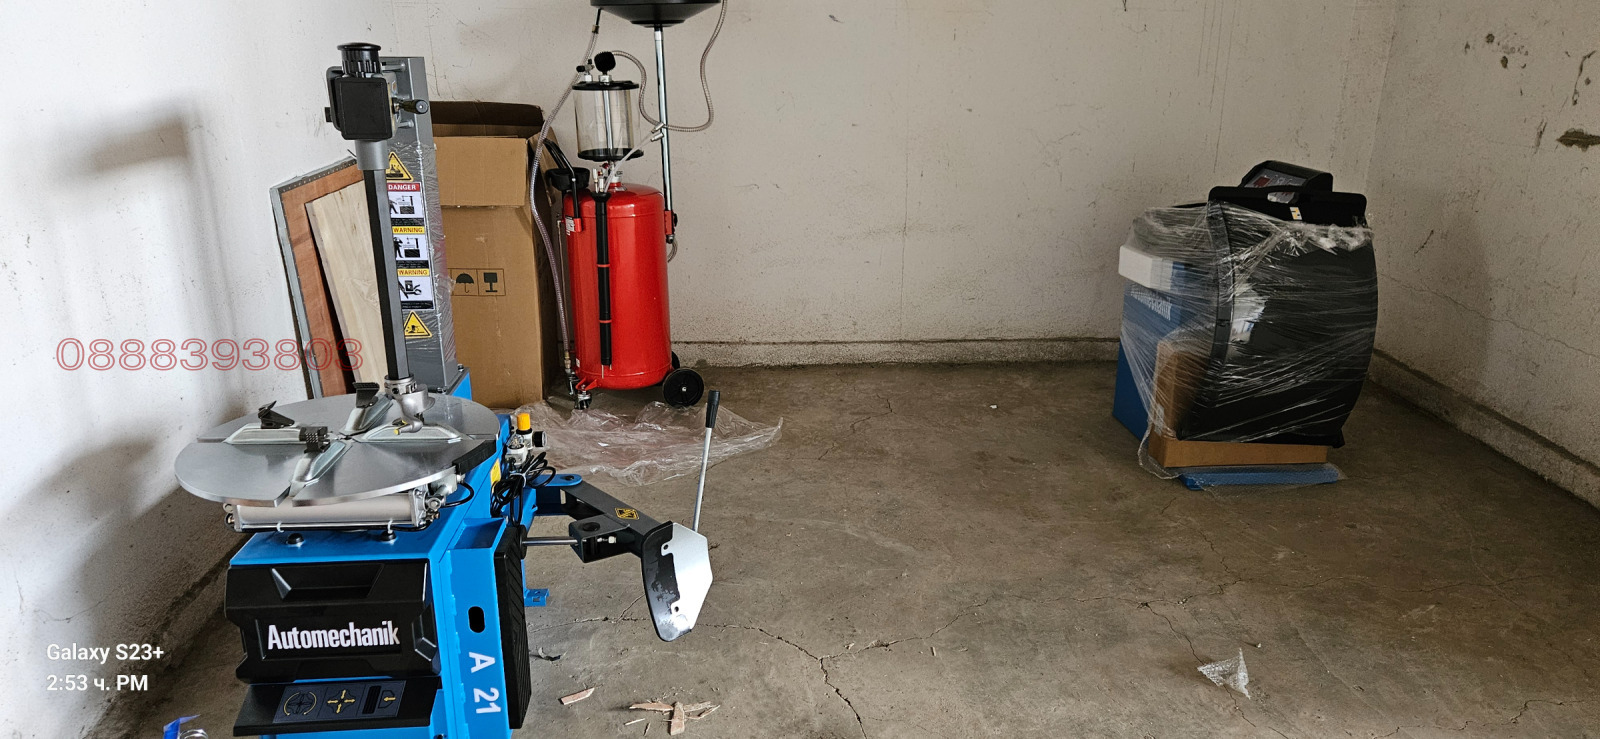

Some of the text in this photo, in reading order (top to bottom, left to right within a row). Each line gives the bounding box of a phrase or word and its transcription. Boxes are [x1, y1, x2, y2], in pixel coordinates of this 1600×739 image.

[267, 620, 400, 650] Automechanik
[468, 651, 501, 713] A 21
